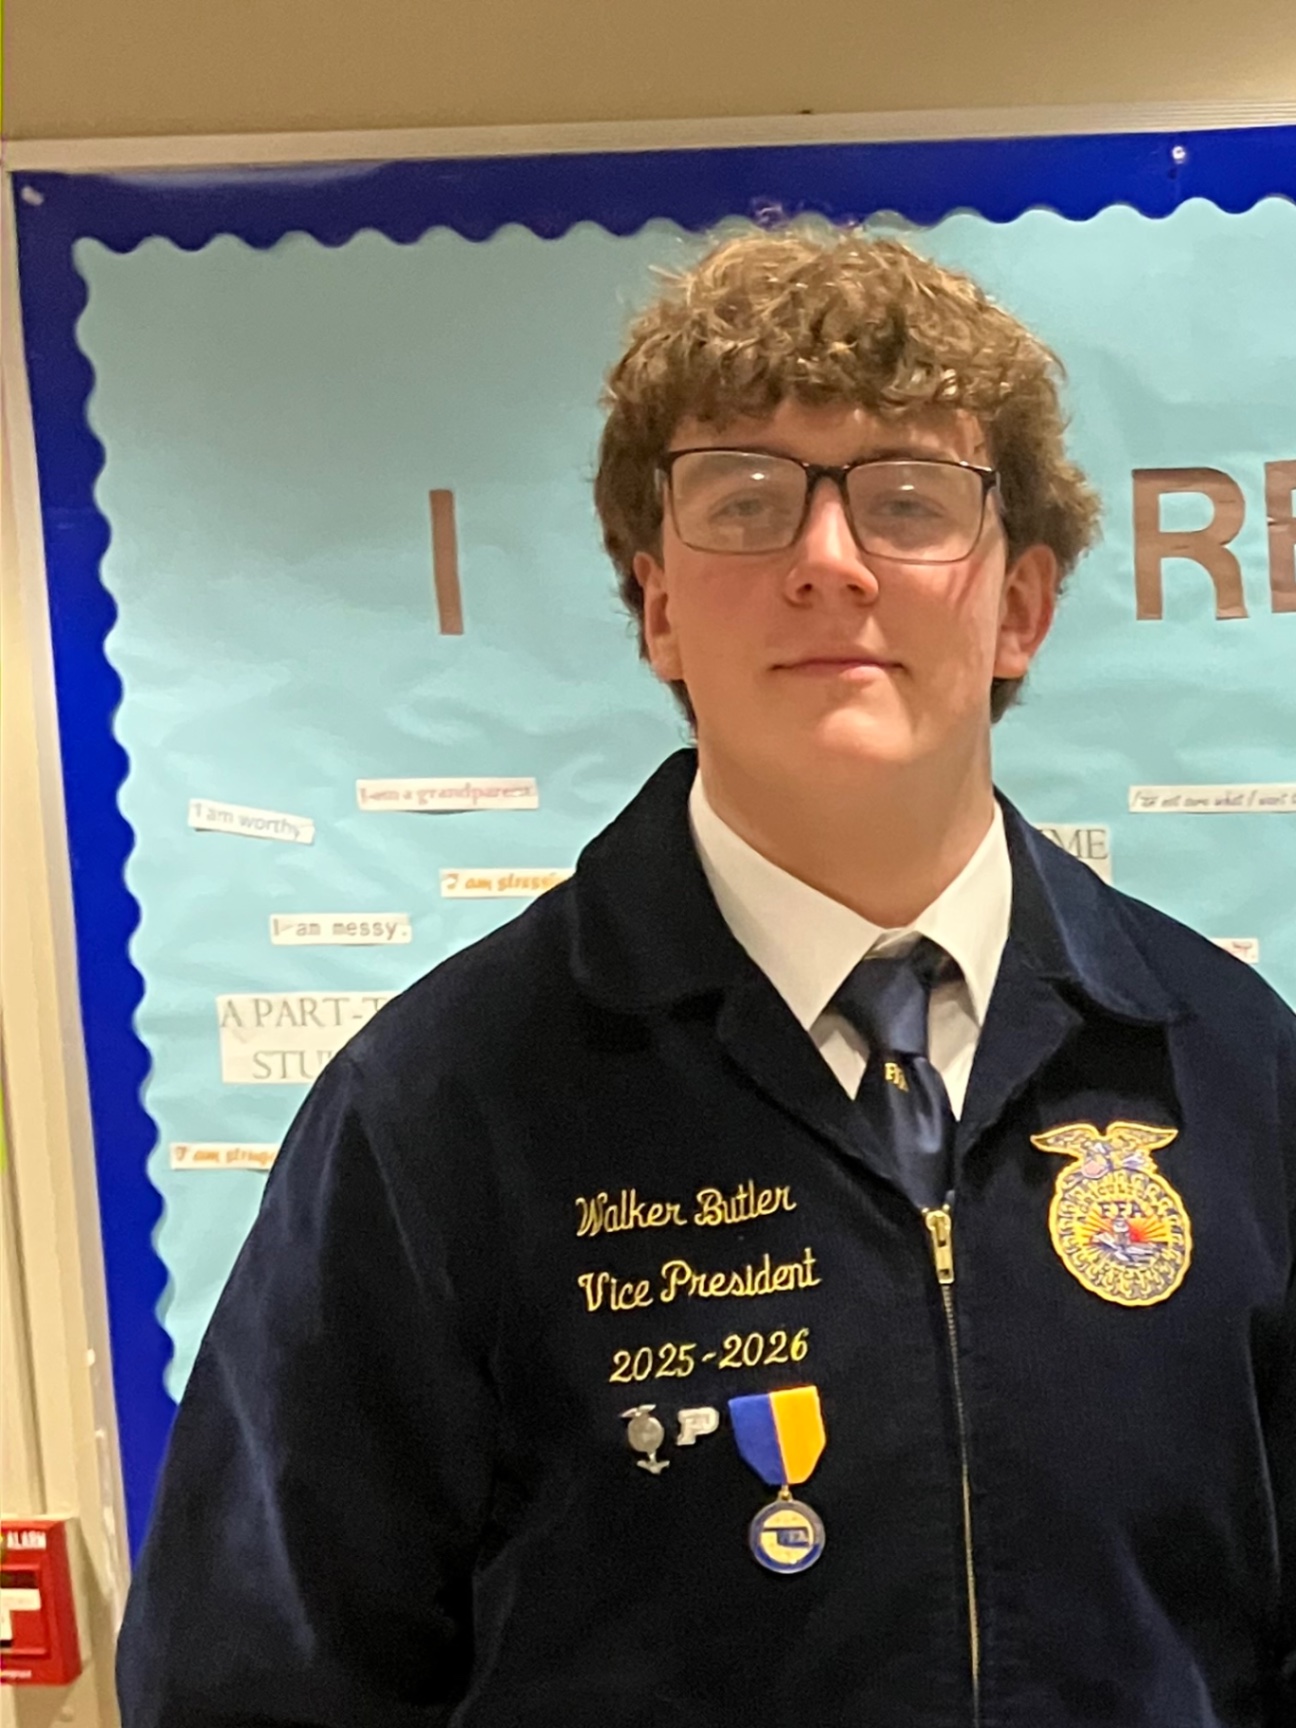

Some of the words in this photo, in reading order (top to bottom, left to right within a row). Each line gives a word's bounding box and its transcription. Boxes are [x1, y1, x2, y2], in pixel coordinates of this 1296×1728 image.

[430, 489, 464, 635] I
[207, 807, 233, 824] am
[273, 918, 280, 937] I
[296, 922, 322, 937] am
[332, 920, 408, 941] messy.
[220, 1000, 243, 1028] A
[575, 1188, 688, 1237] Walker
[694, 1178, 797, 1226] Butler
[1099, 1200, 1146, 1218] FFA
[577, 1271, 654, 1312] Vice
[660, 1247, 822, 1303] President
[609, 1327, 810, 1383] 2025-2026
[675, 1406, 720, 1446] P
